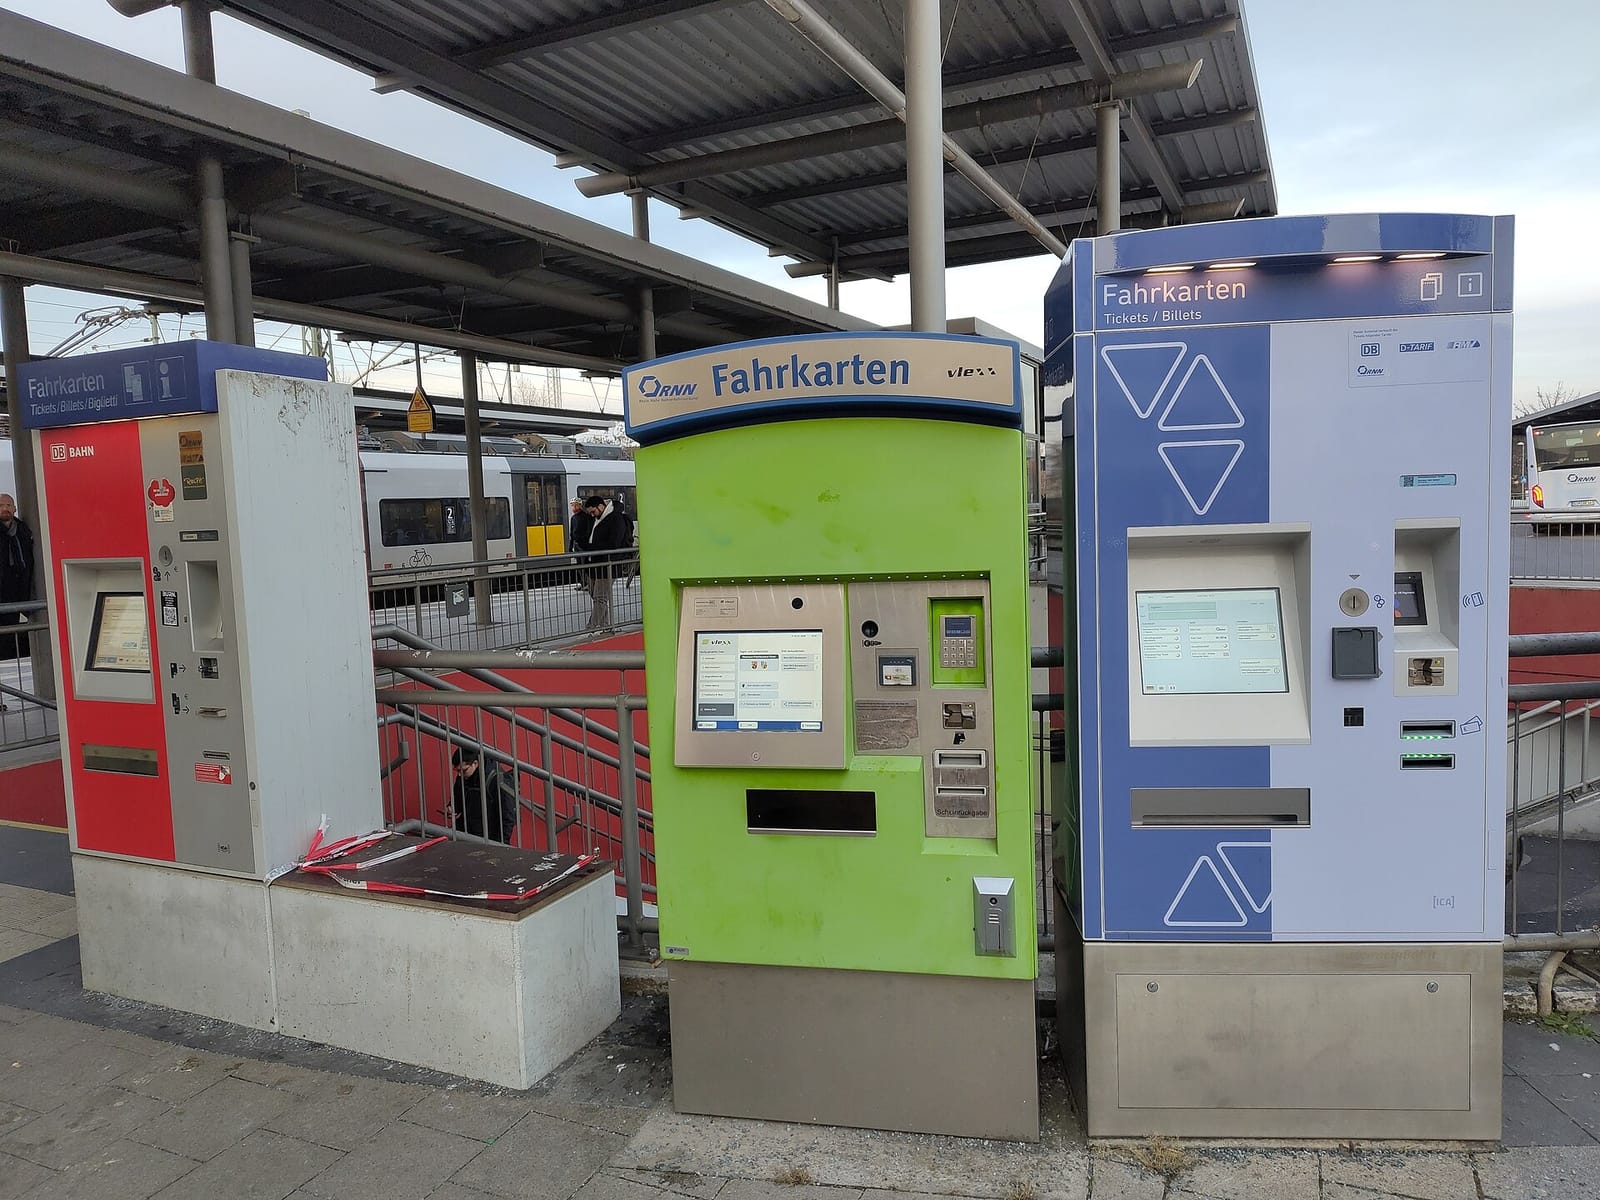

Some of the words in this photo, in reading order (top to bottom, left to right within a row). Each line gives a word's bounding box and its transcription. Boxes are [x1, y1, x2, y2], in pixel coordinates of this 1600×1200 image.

[1103, 280, 1246, 306] Fahrkarten
[1103, 312, 1149, 325] Tickets
[1162, 309, 1202, 322] Billets
[1362, 345, 1379, 356] DB
[711, 354, 910, 397] Fahrkarten
[28, 373, 105, 398] Fahrkarten
[51, 444, 66, 460] DB
[69, 445, 94, 458] BAHN
[447, 508, 453, 519] 2
